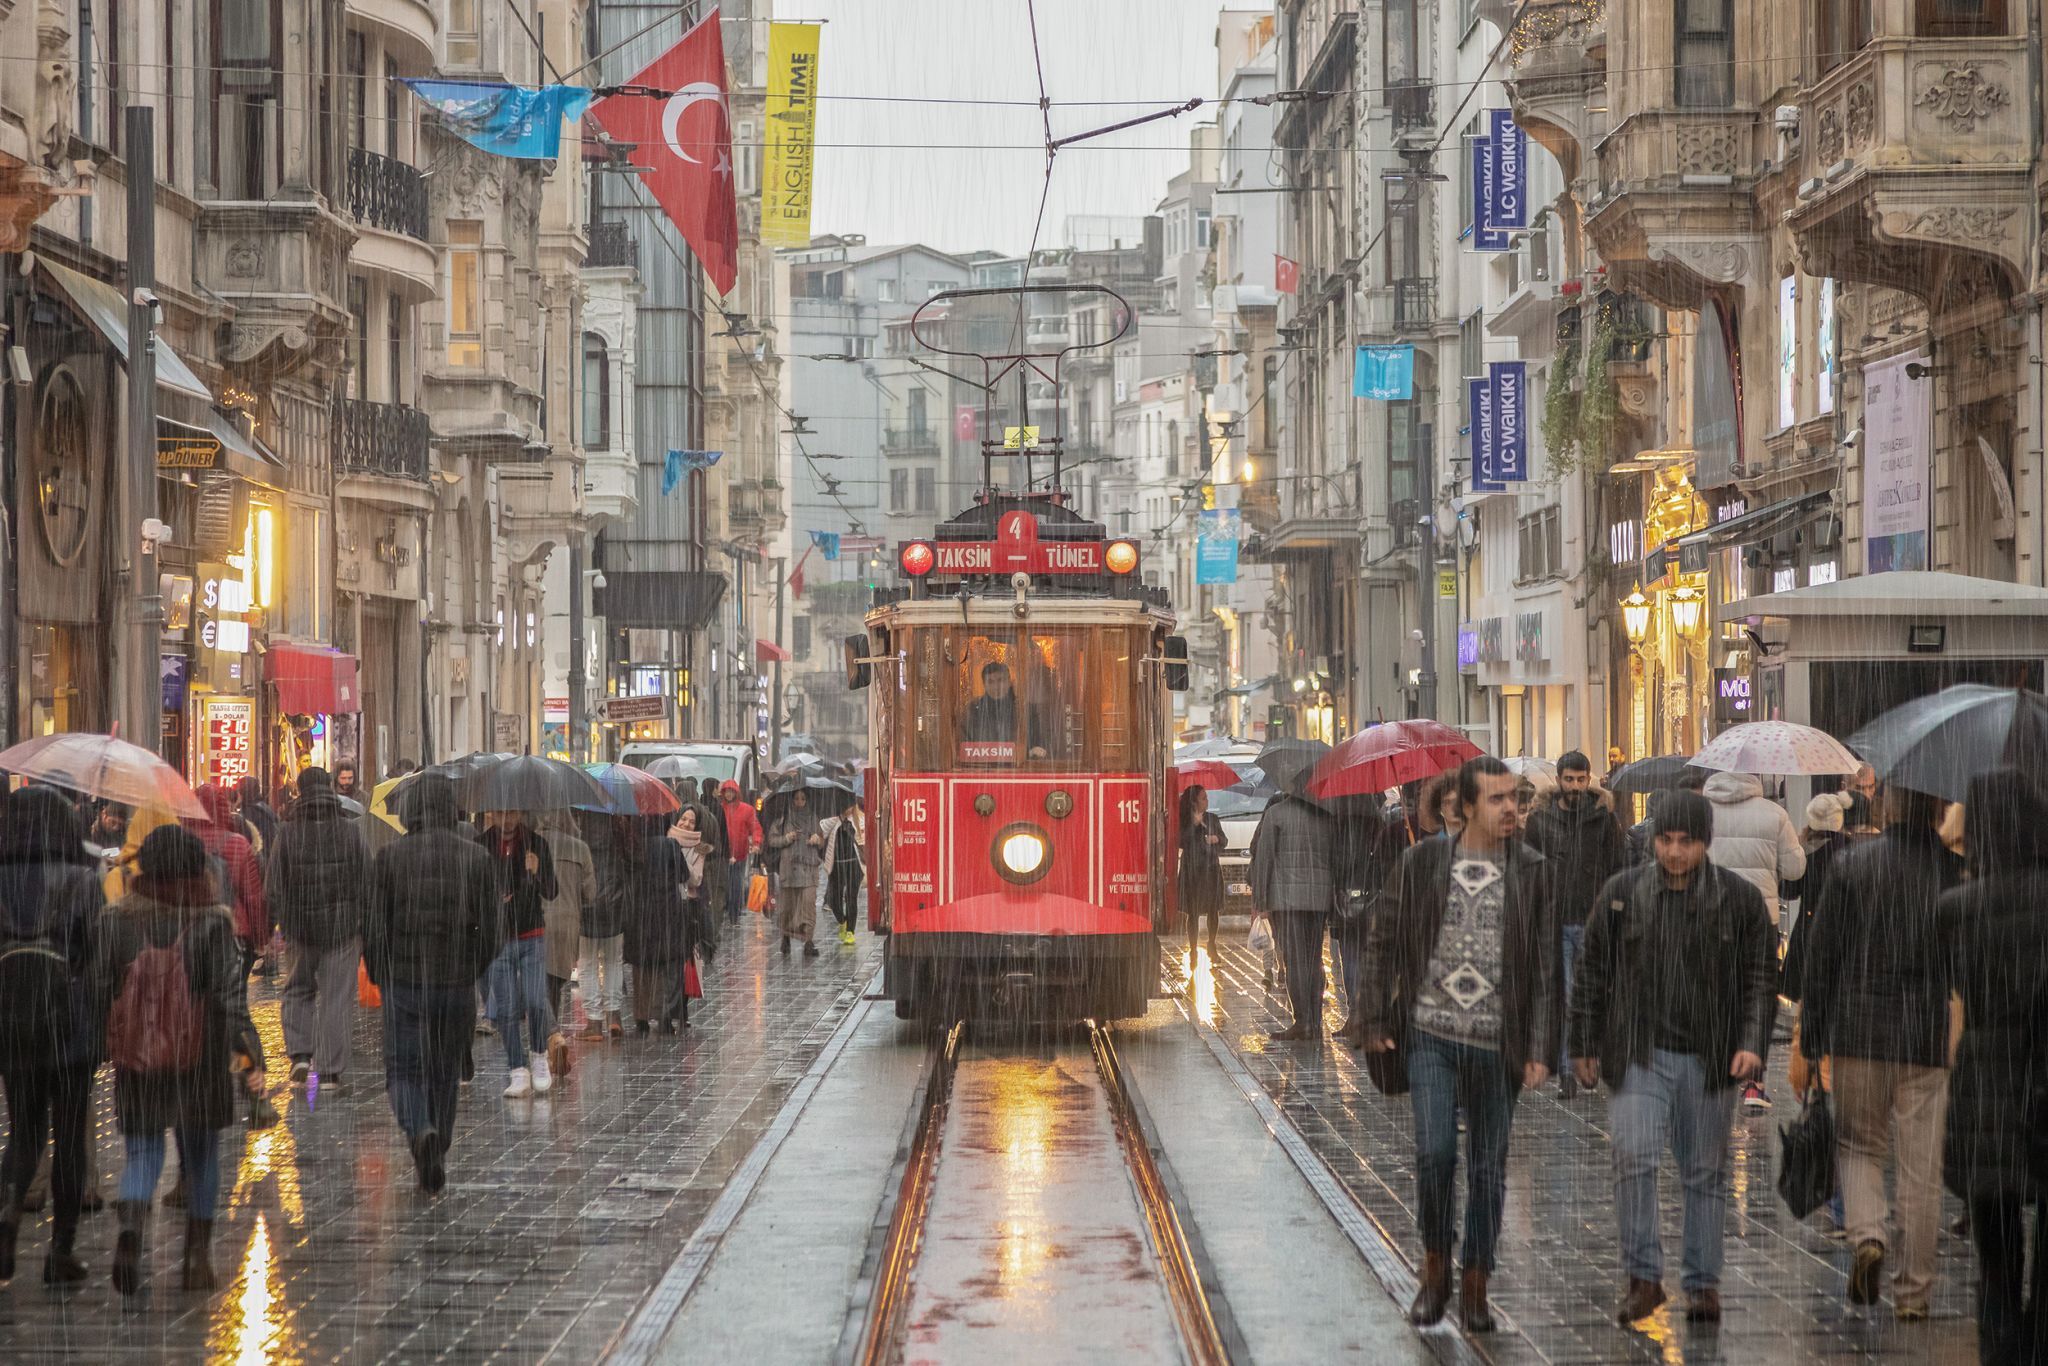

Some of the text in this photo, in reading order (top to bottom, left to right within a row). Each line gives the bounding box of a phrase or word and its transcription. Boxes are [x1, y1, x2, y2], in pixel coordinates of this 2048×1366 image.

[784, 53, 808, 219] ENGLISH TIME
[1501, 195, 1516, 219] LC
[1501, 448, 1516, 473] LC
[1009, 516, 1021, 540] 4
[936, 545, 992, 568] TAKSİM
[1046, 545, 1099, 568] TÜNEL
[964, 746, 1014, 757] TAKSİM
[220, 758, 249, 773] 950
[903, 798, 927, 822] 115
[1117, 799, 1140, 824] 115
[1109, 884, 1119, 894] VE
